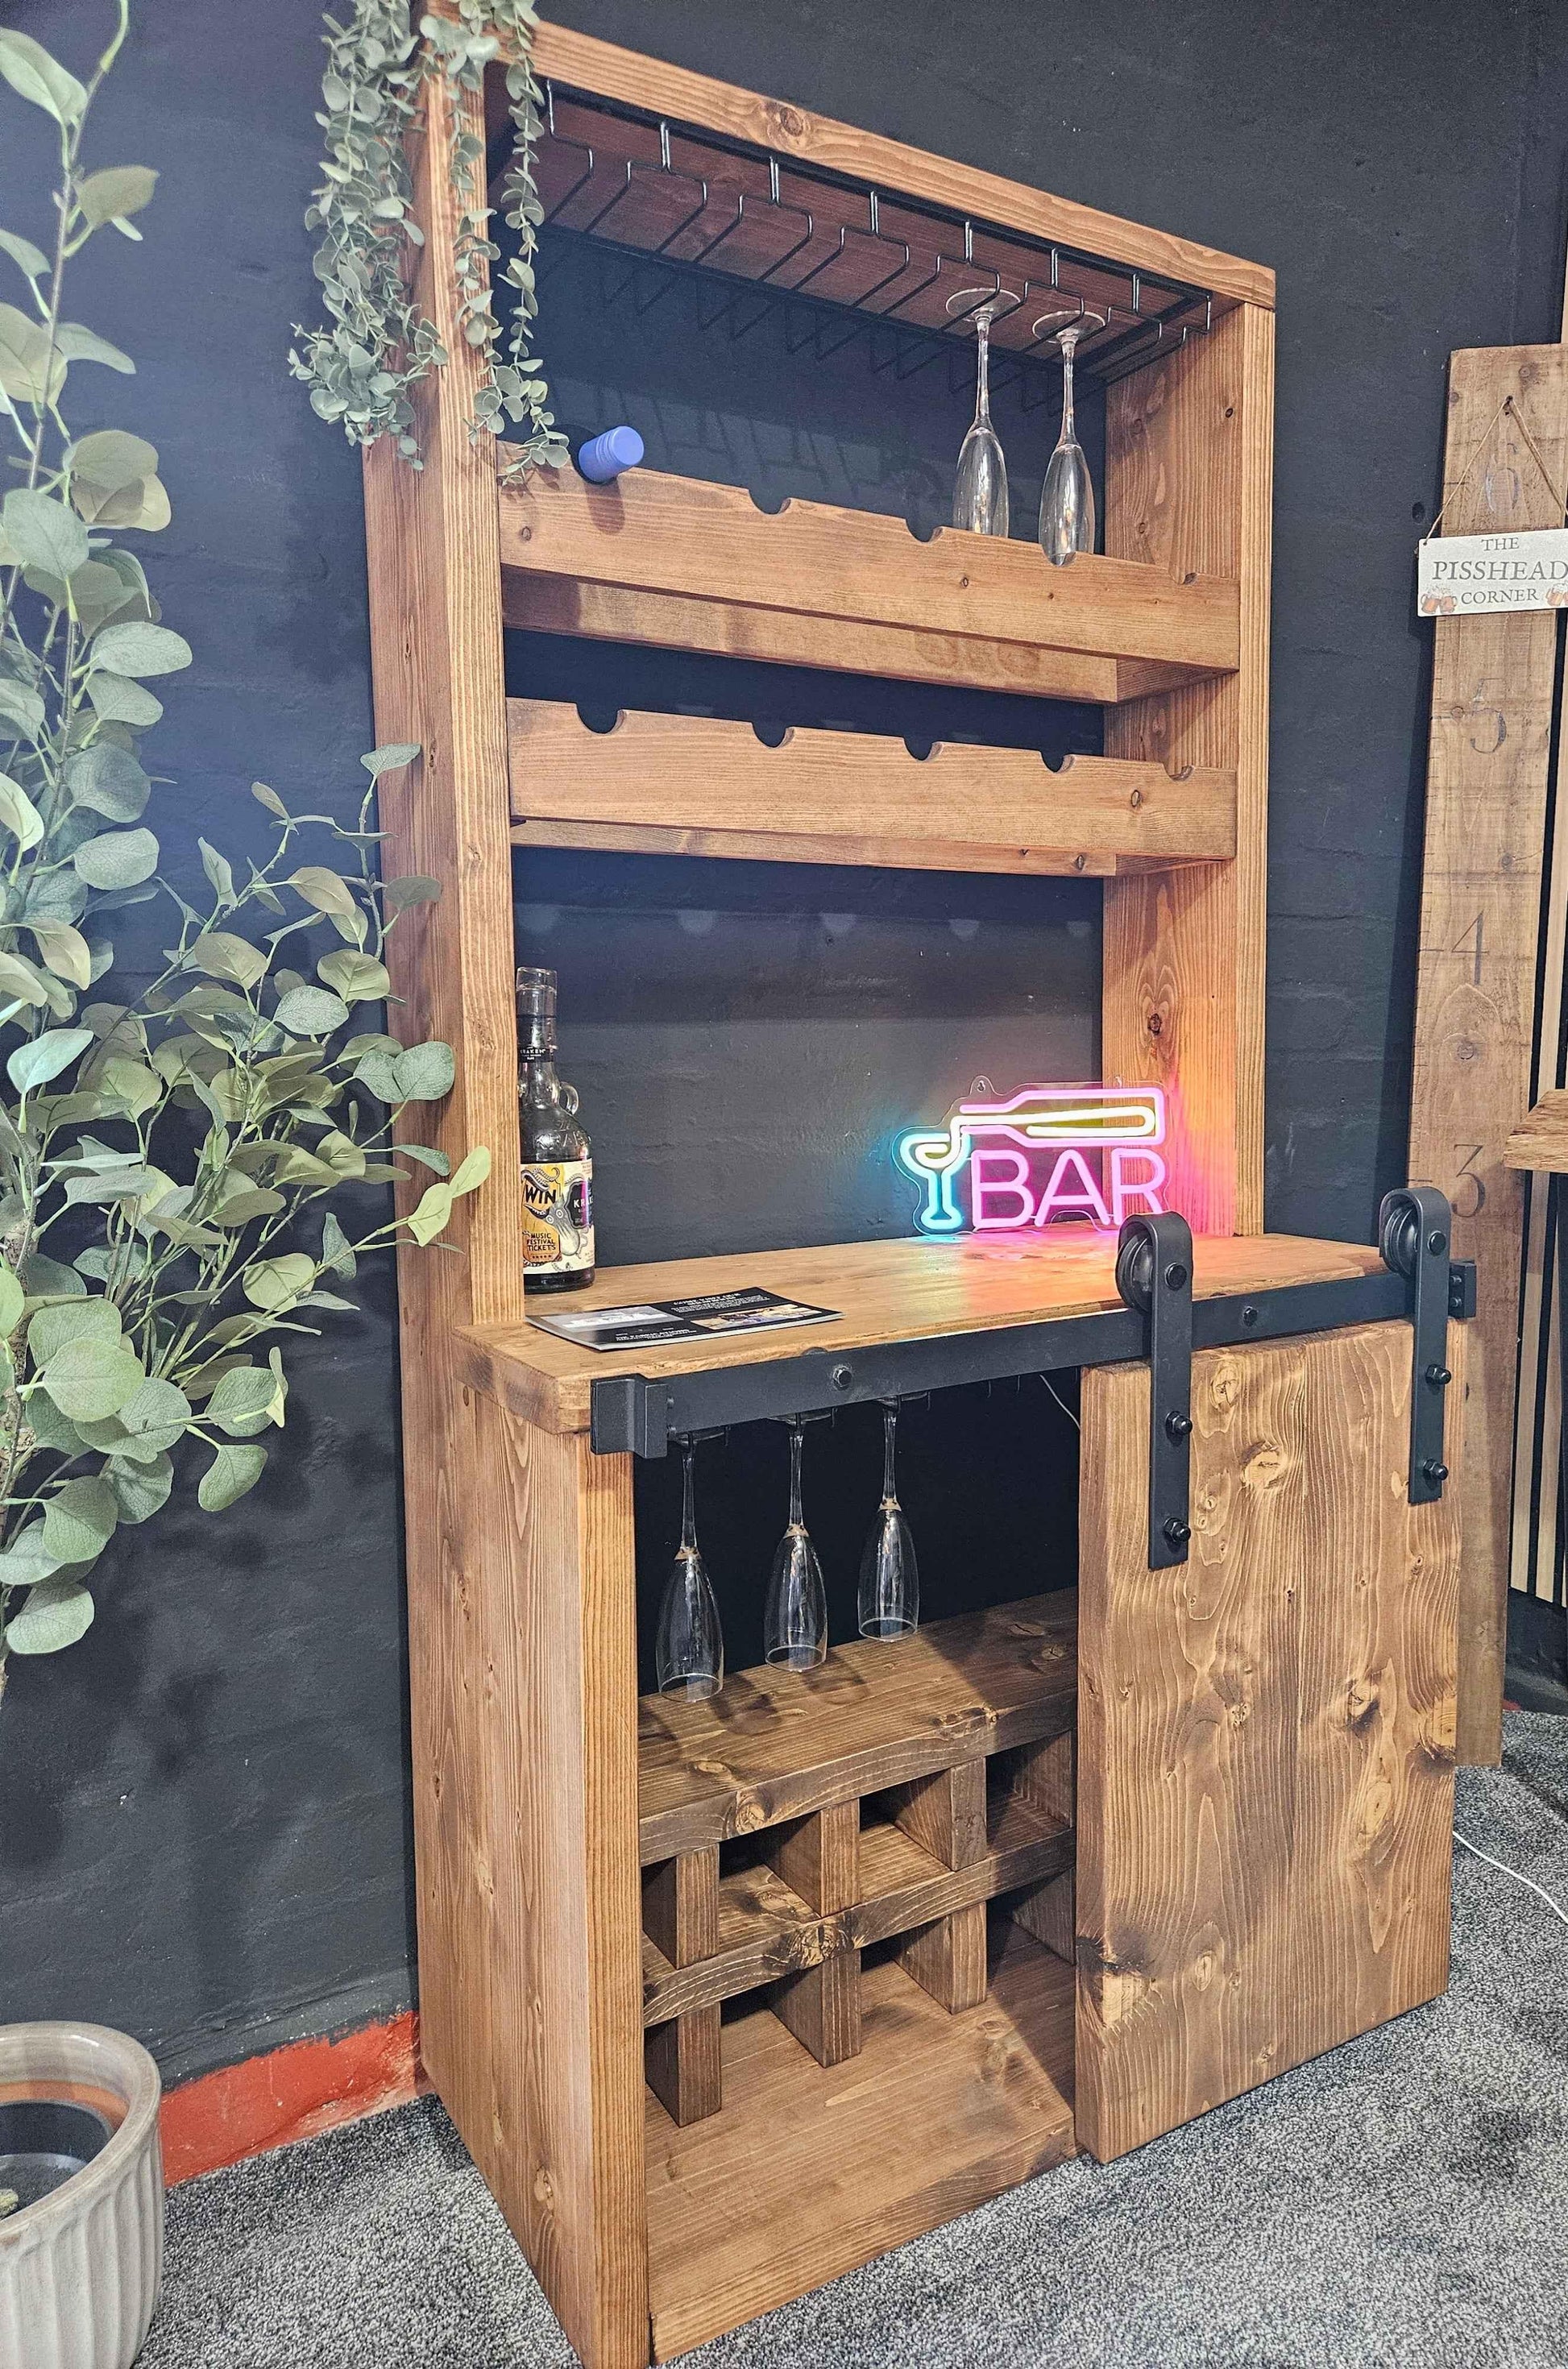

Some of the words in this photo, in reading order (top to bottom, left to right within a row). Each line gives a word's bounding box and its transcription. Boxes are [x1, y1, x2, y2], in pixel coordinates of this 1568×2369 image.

[1482, 537, 1520, 552] THE
[1432, 560, 1568, 580] PISSHEAD
[1461, 588, 1539, 606] CORNER
[1470, 678, 1507, 754] 5
[1451, 910, 1489, 986] 4
[525, 1184, 556, 1204] WIN
[970, 1148, 1166, 1229] BAR
[1451, 1143, 1486, 1218] 3
